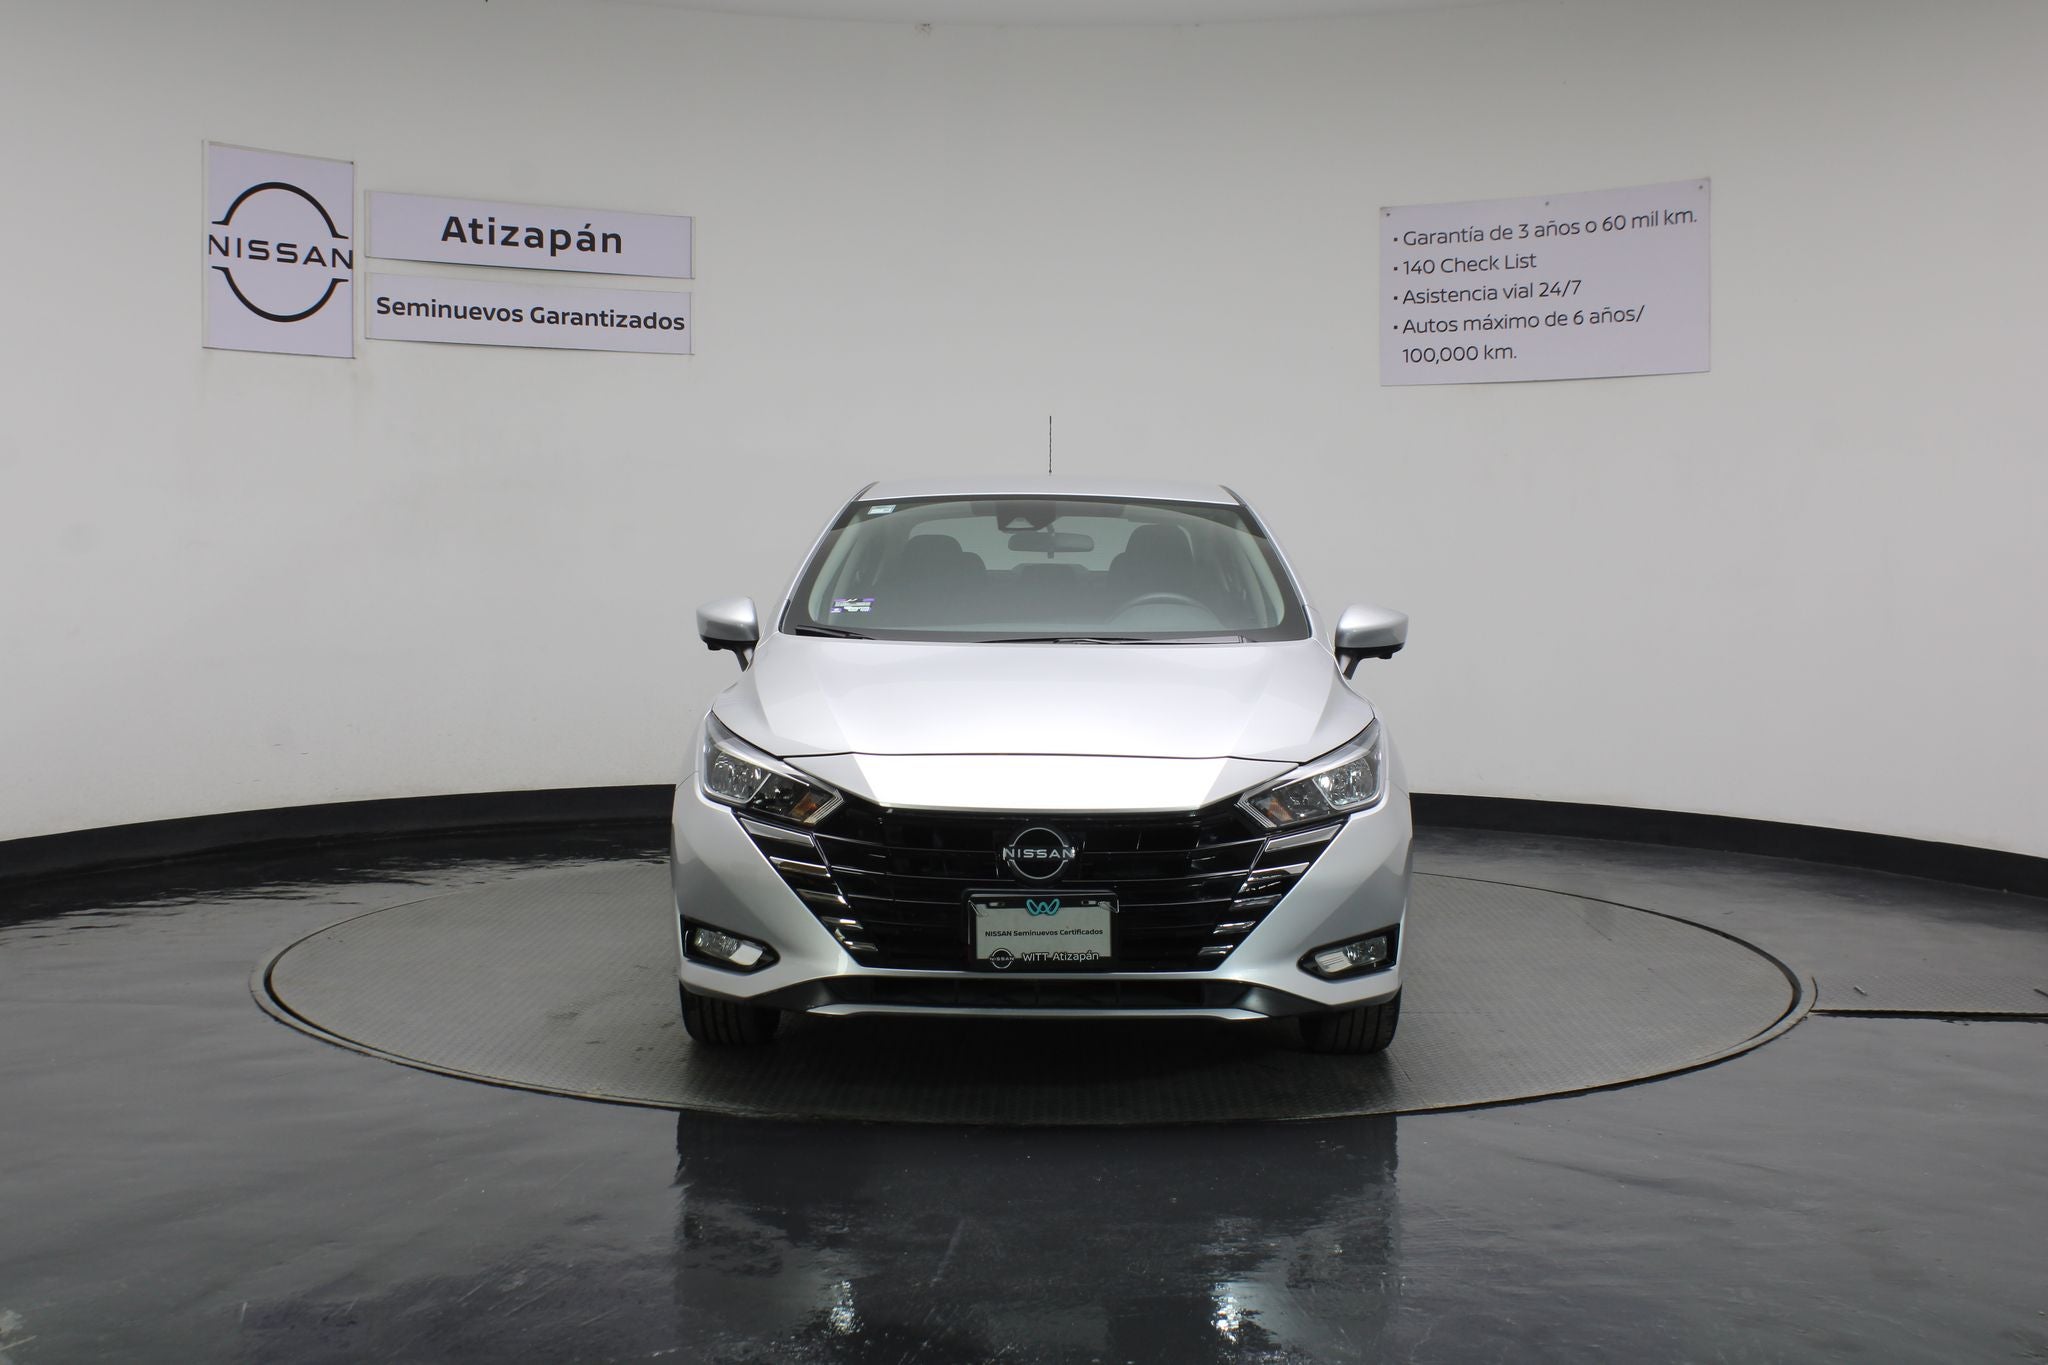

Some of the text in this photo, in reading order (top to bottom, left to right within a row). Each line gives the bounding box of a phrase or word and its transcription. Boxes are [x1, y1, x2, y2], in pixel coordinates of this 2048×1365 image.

[441, 215, 623, 257] Atizapán
[1403, 209, 1698, 246] Garantía de 3 años o 60 mil km.
[208, 233, 353, 269] NISSAN
[1402, 253, 1537, 276] 140 Check List
[1402, 279, 1582, 305] Asistencia vial 24/7
[376, 296, 685, 331] Seminuevos Garantizados
[1402, 304, 1646, 335] Autos máximo de 6 años/
[1402, 344, 1517, 365] 100,000 km.
[1003, 848, 1075, 859] NISSAN
[1022, 950, 1099, 963] WITT Atizapán
